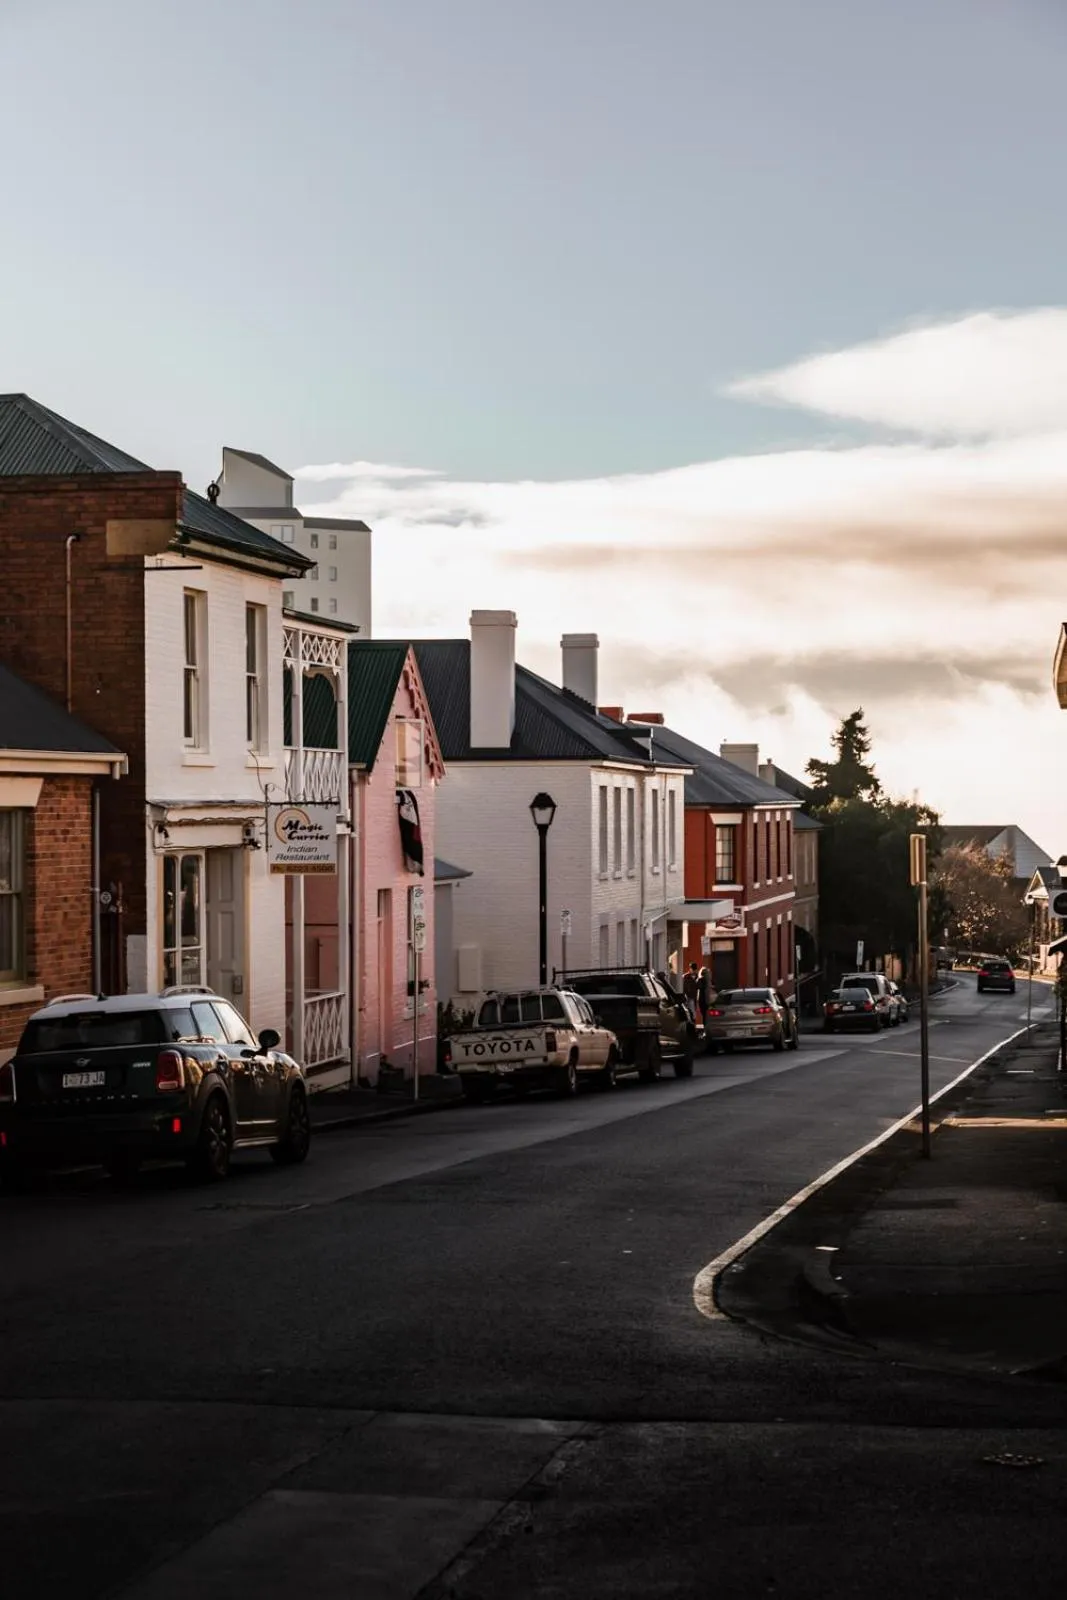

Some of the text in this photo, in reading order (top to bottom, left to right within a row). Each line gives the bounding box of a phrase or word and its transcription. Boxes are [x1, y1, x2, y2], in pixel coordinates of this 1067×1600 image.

[282, 820, 323, 832] Magic
[287, 830, 330, 840] Curries
[462, 1040, 536, 1056] TOYOTA
